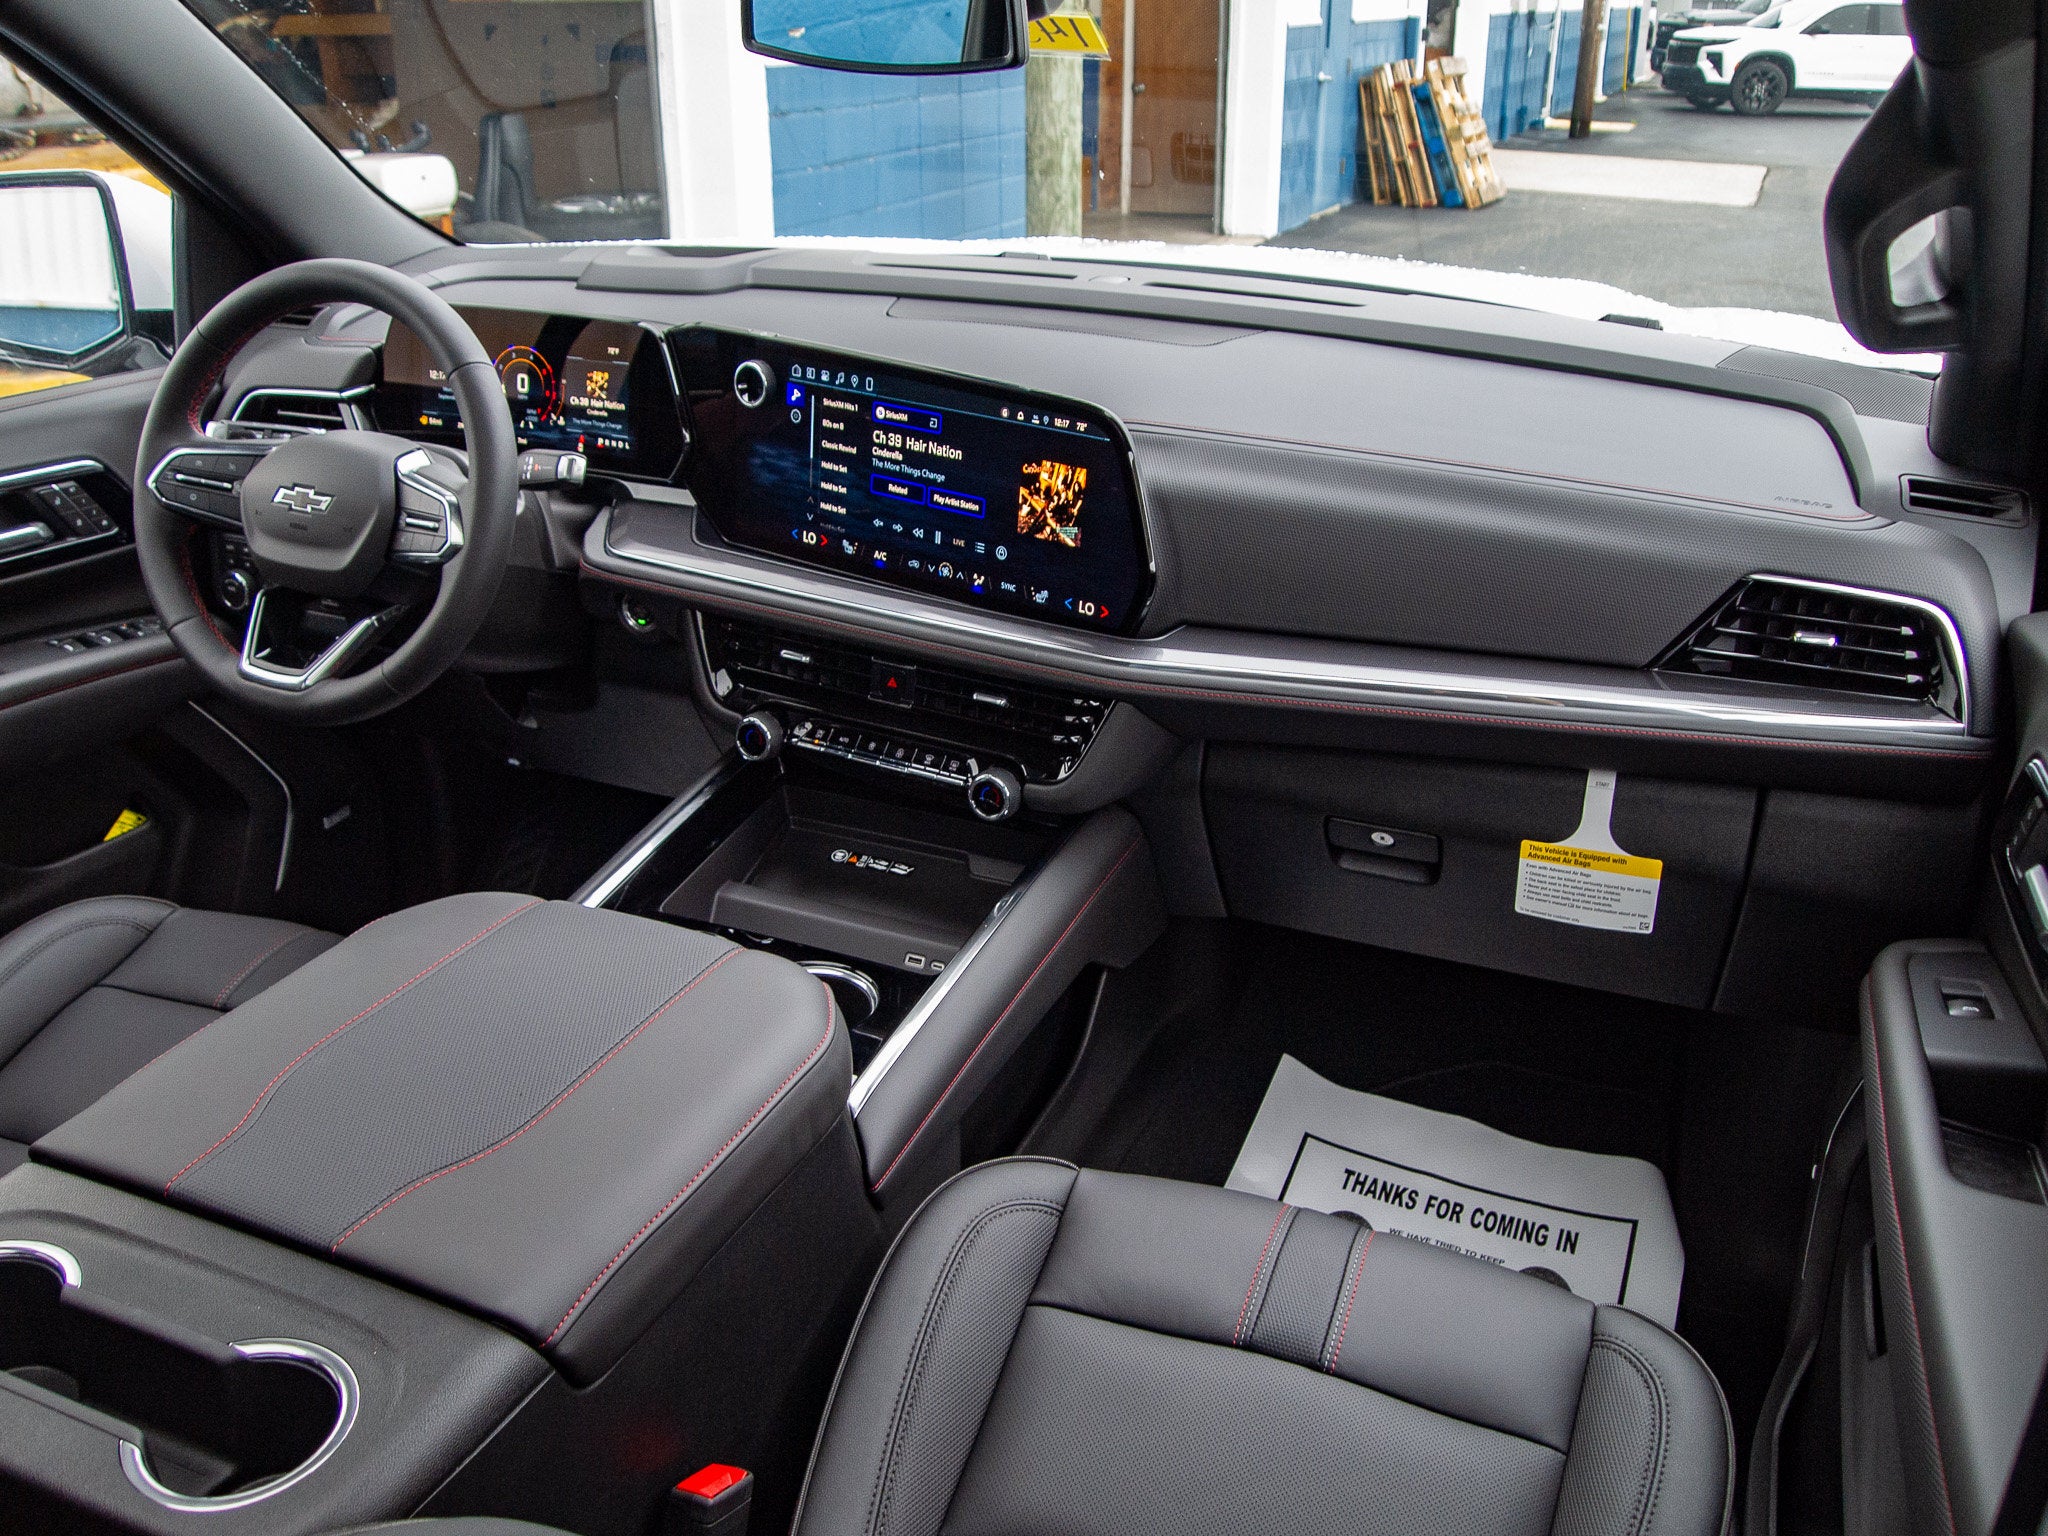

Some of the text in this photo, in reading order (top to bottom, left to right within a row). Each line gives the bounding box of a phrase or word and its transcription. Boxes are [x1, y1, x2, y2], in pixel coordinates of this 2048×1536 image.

[517, 373, 529, 394] 0
[604, 400, 626, 411] Nation
[823, 397, 844, 409] SiriusXM
[886, 409, 908, 422] SiriusXM
[1054, 417, 1070, 428] 12:17
[872, 430, 963, 460] Ch 39 Hair Nation
[872, 446, 903, 461] Cinderella
[821, 460, 832, 470] Hold
[839, 464, 848, 473] Set
[872, 458, 946, 483] The More Things Change
[820, 481, 832, 491] Hold
[838, 485, 847, 494] Set
[888, 483, 908, 496] Related
[820, 501, 832, 511] Hold
[838, 505, 847, 515] Set
[933, 493, 980, 512] Play Artist Station
[803, 530, 817, 545] LO
[952, 538, 965, 547] LIVE
[873, 550, 887, 561] A/C
[1001, 581, 1017, 592] SYNC
[1078, 600, 1095, 616] LO
[1528, 851, 1591, 868] Advanced Air Bags
[1529, 844, 1543, 853] This
[1544, 846, 1569, 856] Vehicle
[1579, 852, 1611, 863] Equipped
[1612, 857, 1628, 865] with
[1342, 1168, 1580, 1255] THANKS FOR COMING IN
[1390, 1227, 1405, 1237] WE
[1406, 1232, 1431, 1243] HAVE
[1435, 1239, 1461, 1252] TRIED
[1465, 1248, 1477, 1257] TO
